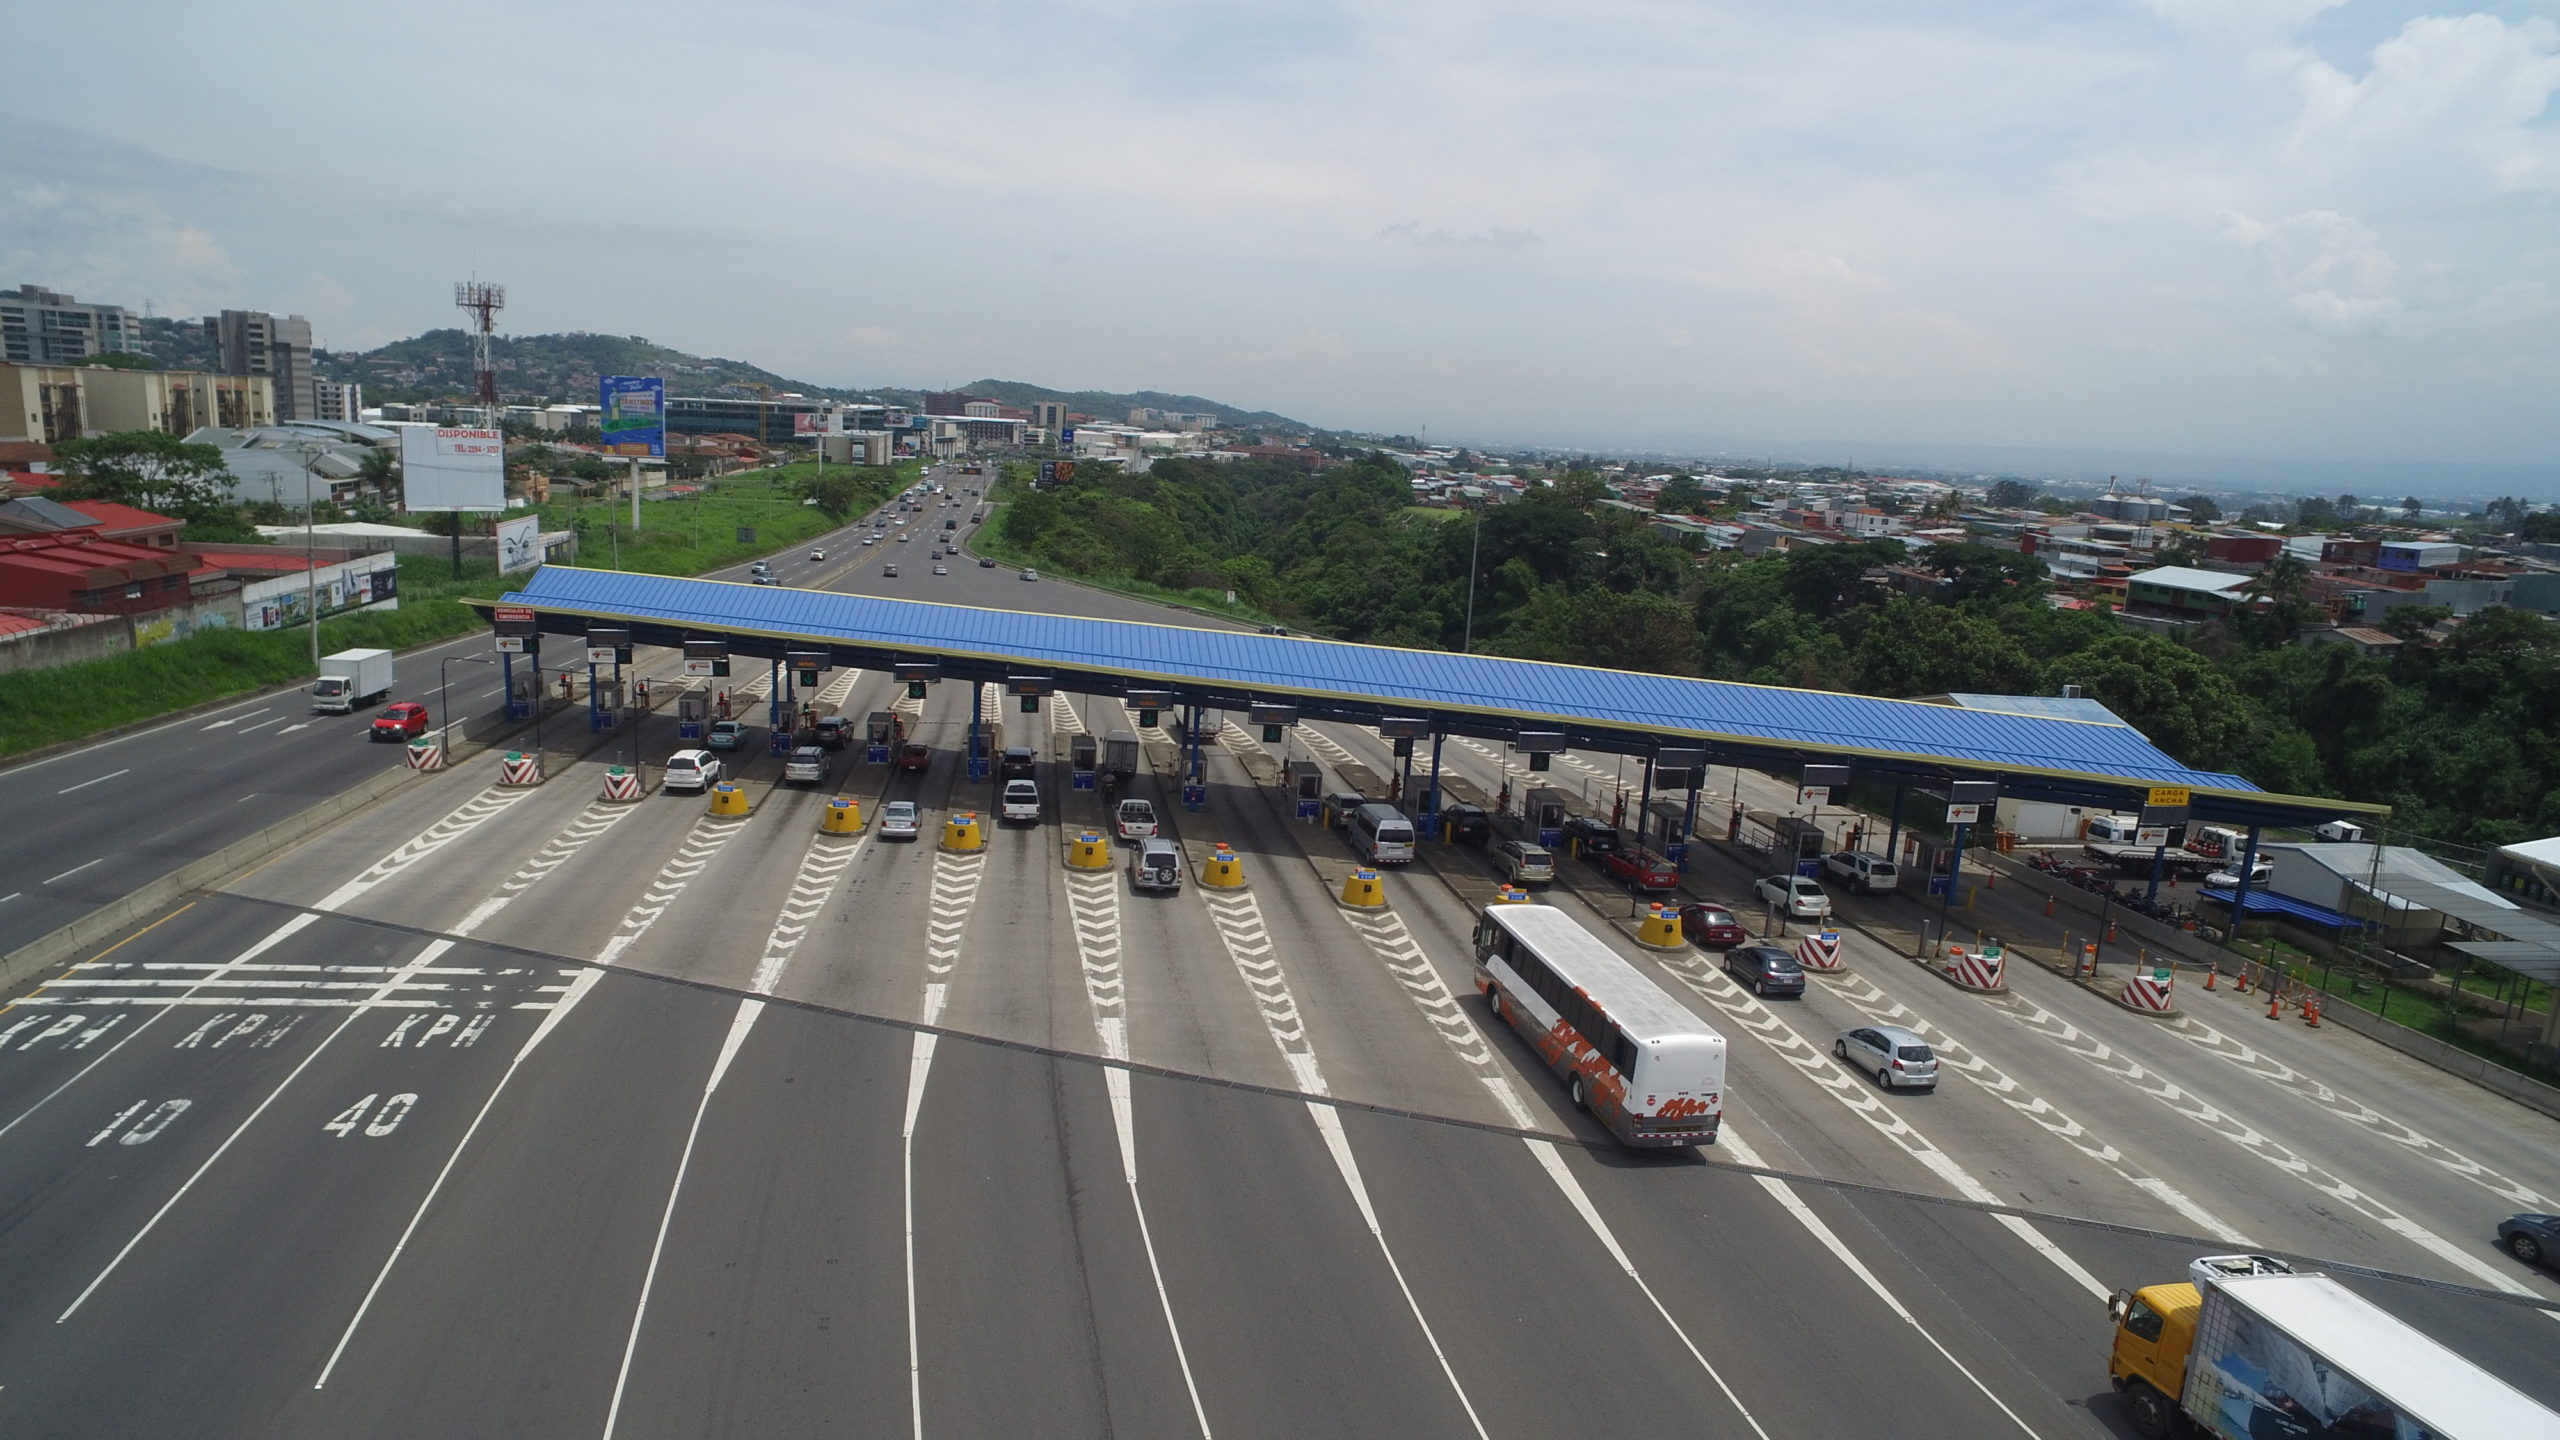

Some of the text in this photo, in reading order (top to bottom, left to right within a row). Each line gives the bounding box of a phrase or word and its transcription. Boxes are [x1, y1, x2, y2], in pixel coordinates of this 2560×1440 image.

[437, 429, 499, 439] DISPONIBLE
[454, 444, 467, 453] TEL:
[173, 1013, 304, 1049] KPH
[380, 1013, 496, 1049] KPH
[322, 1092, 419, 1138] 40
